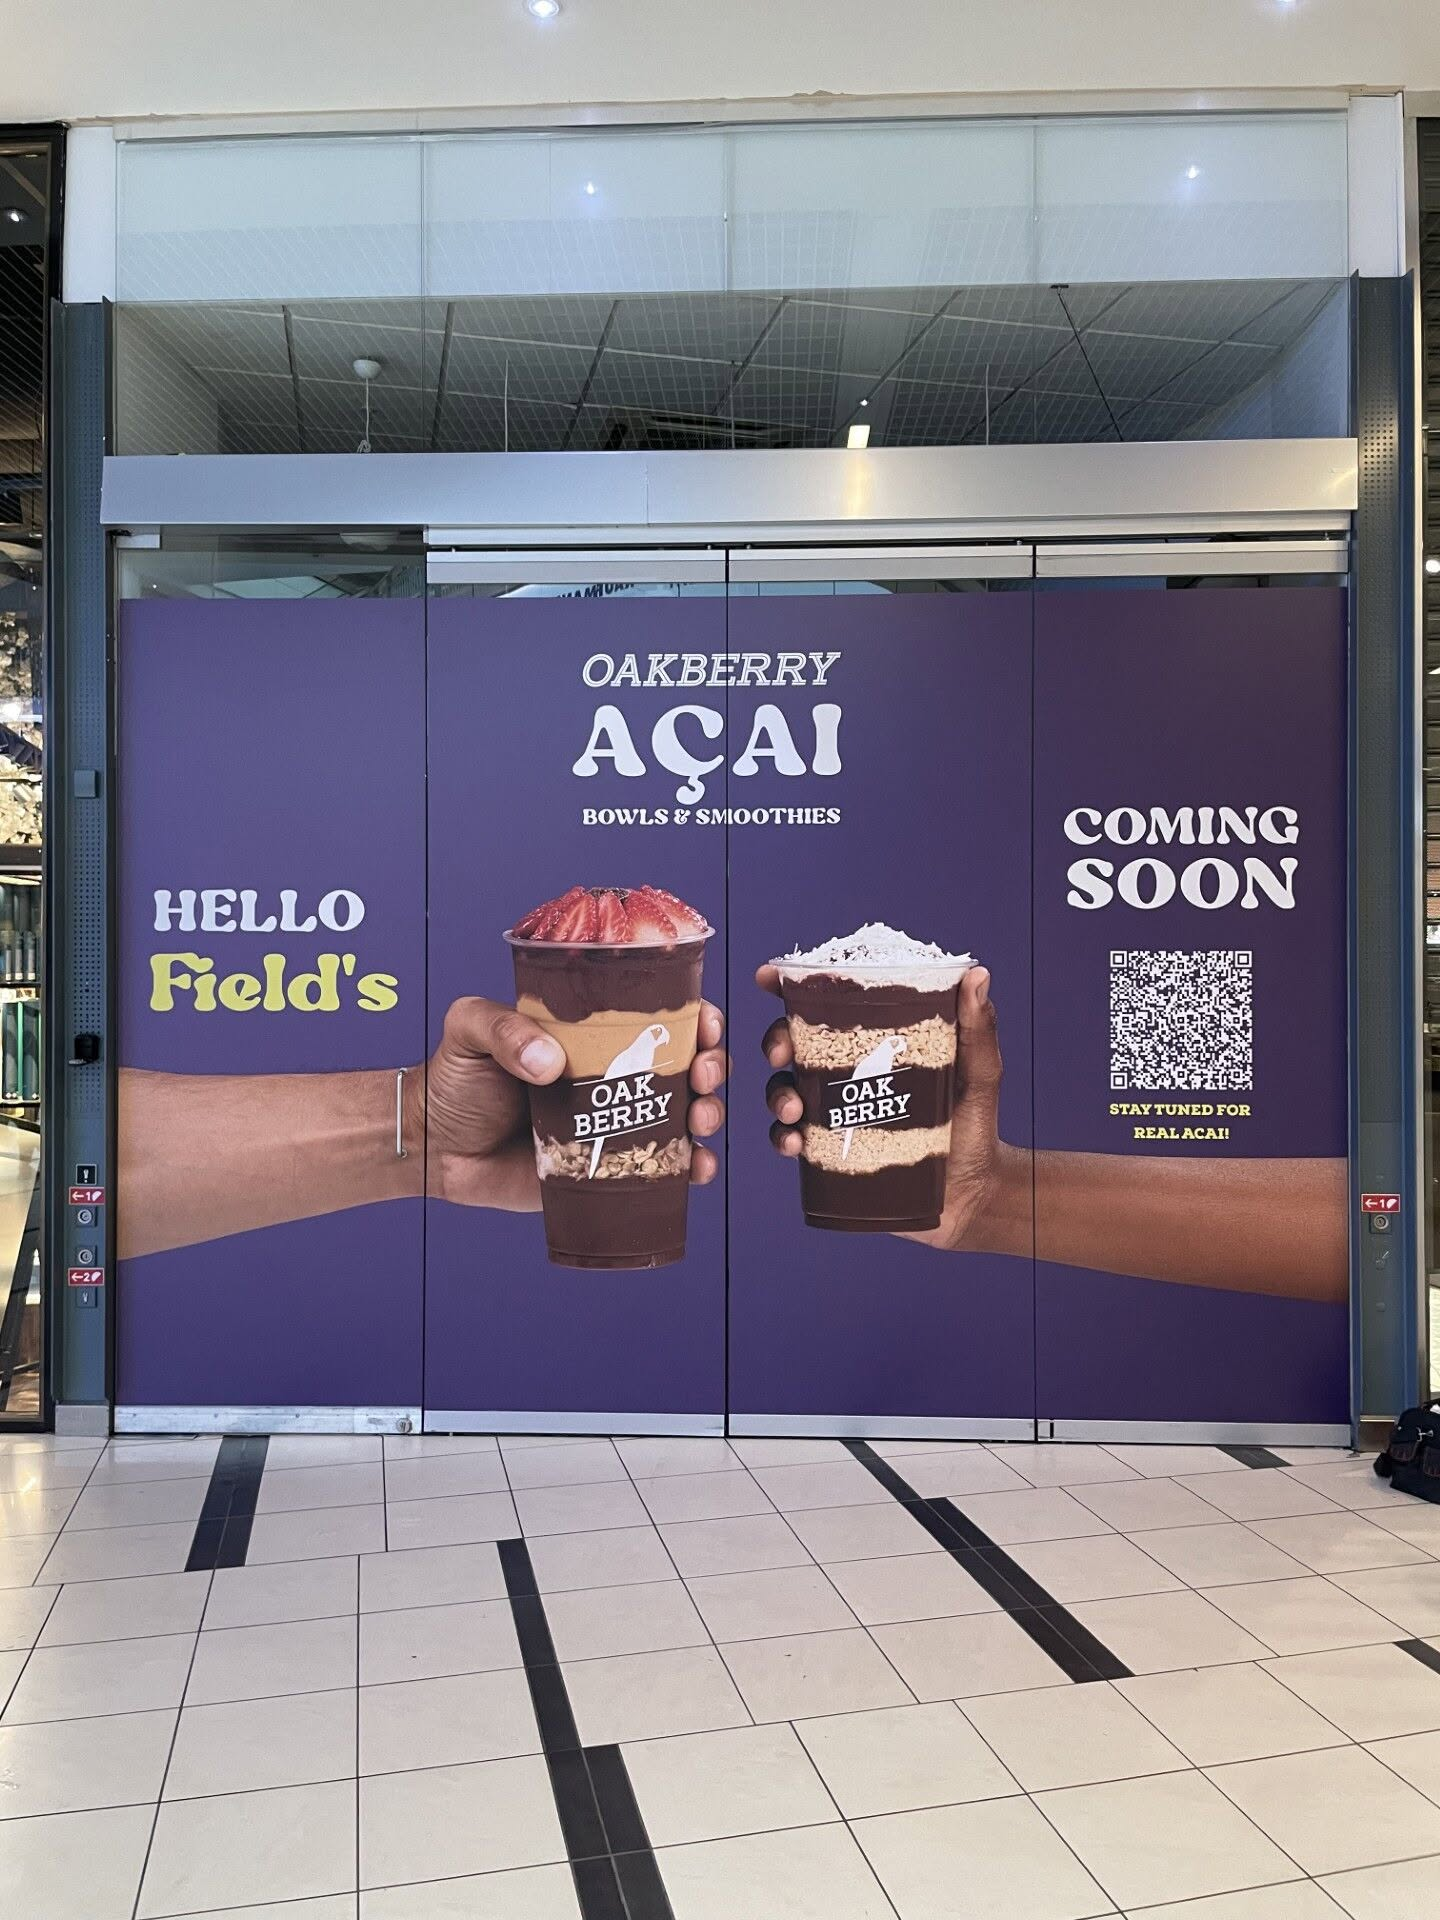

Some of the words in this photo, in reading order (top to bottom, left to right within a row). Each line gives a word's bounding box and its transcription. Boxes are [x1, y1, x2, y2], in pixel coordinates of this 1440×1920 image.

[582, 652, 841, 687] OAKBERRY
[572, 703, 842, 805] AÇAI
[583, 808, 669, 825] BOWLS
[673, 809, 691, 825] &
[695, 807, 841, 825] SMOOTHIES
[1063, 806, 1300, 845] COMING
[1066, 857, 1299, 910] SOON
[153, 889, 366, 932] HELLO
[149, 952, 399, 1012] Field's
[591, 1073, 655, 1108] OAK
[841, 1076, 895, 1104] OAK
[573, 1092, 673, 1137] BERRY
[828, 1093, 912, 1128] BERRY
[1109, 1103, 1152, 1115] STAY
[1154, 1104, 1214, 1116] TUNED
[1216, 1104, 1251, 1116] FOR
[1134, 1127, 1179, 1139] REAL
[1181, 1127, 1230, 1139] ACAI!
